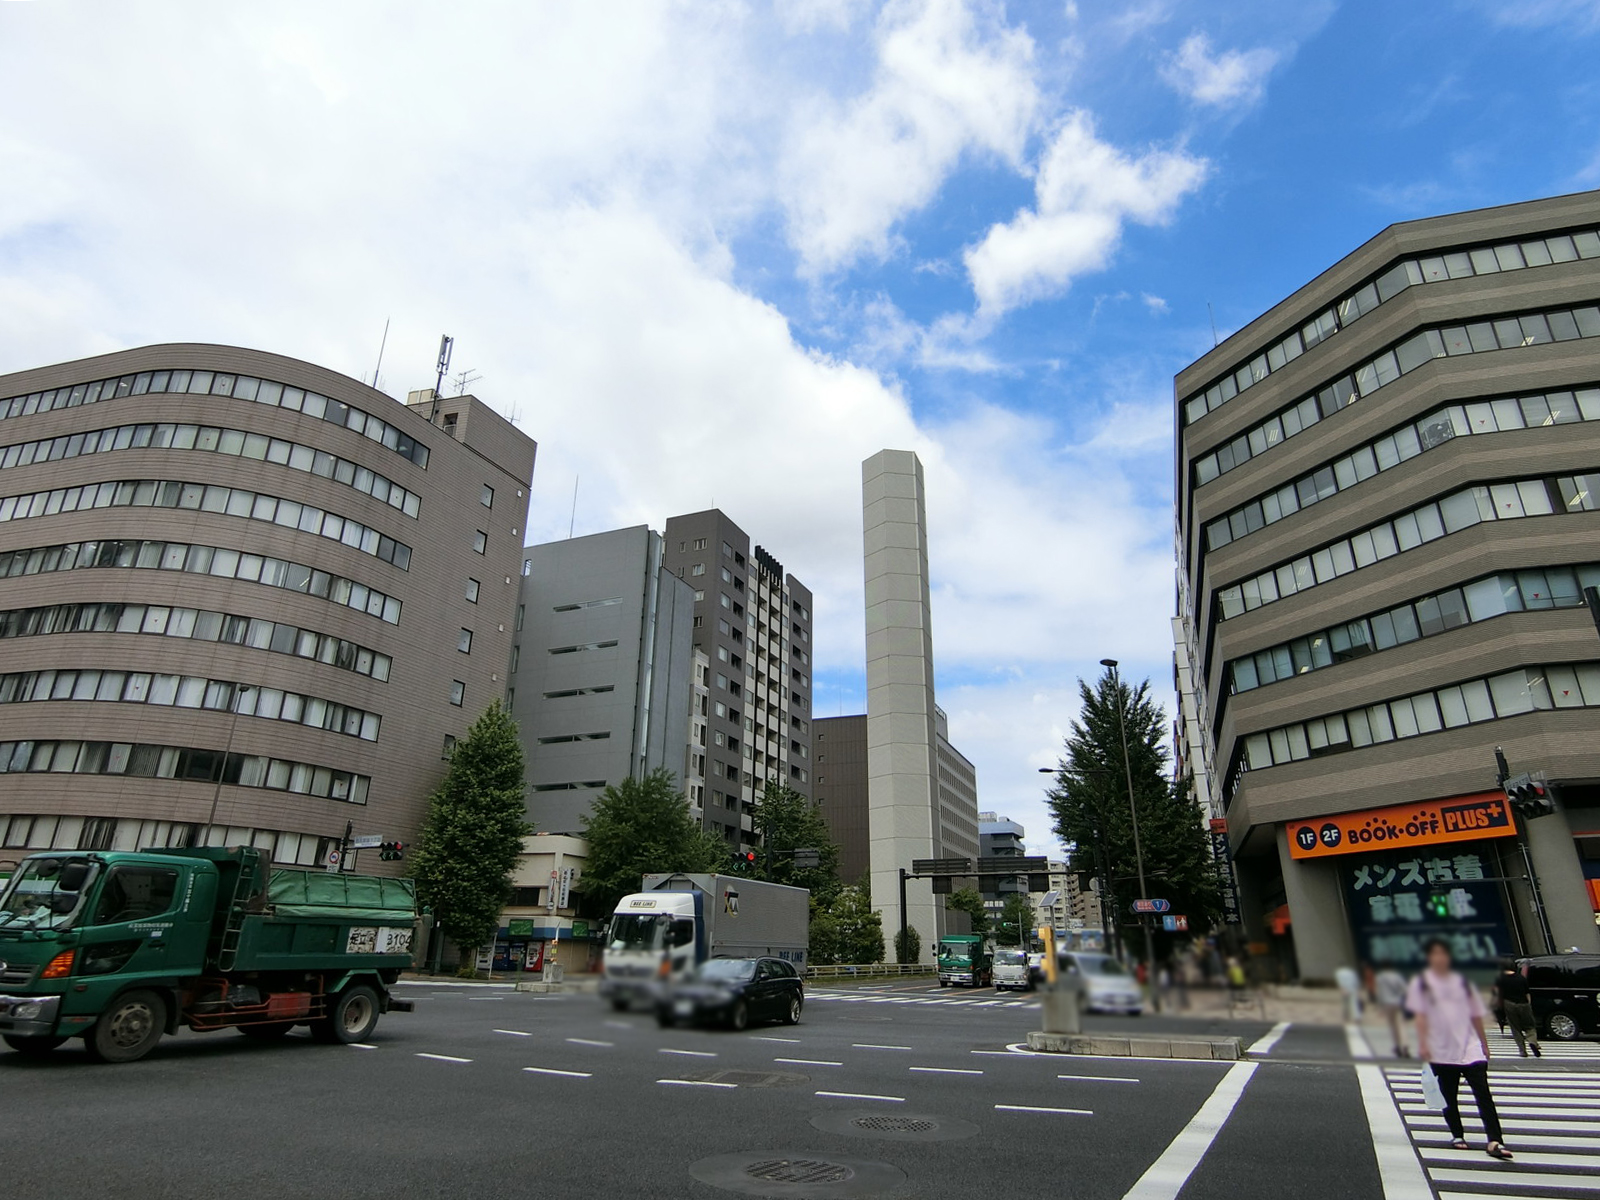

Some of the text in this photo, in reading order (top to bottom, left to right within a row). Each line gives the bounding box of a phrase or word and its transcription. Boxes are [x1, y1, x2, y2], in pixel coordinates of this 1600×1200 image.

[1300, 832, 1314, 845] 1F
[1323, 829, 1339, 842] 2F
[1354, 854, 1484, 890] メンズ古着
